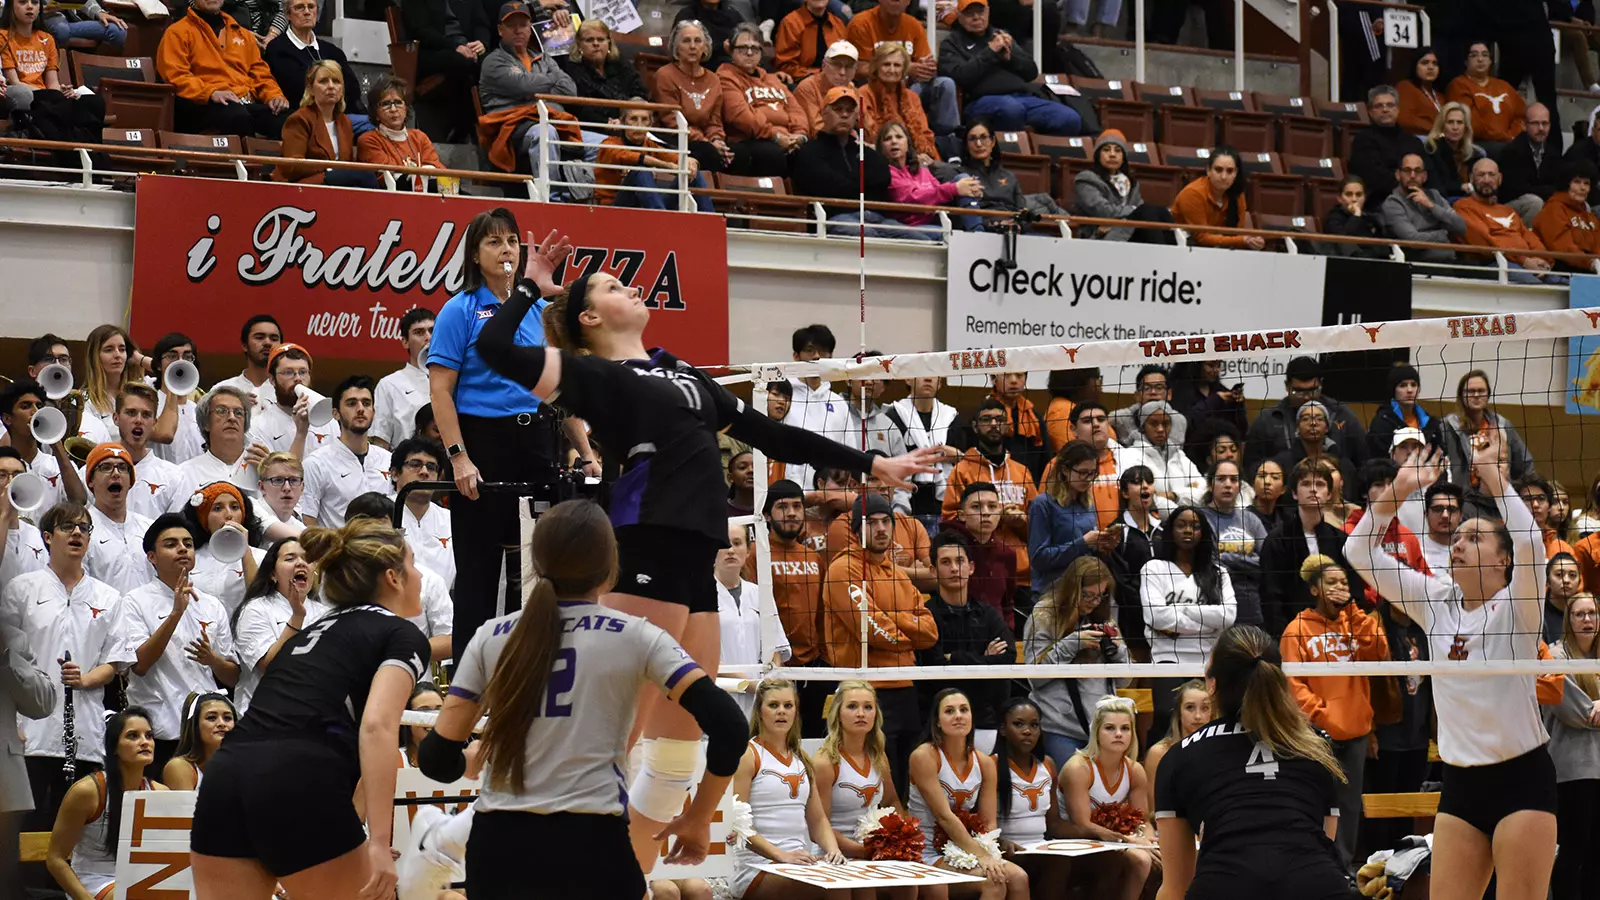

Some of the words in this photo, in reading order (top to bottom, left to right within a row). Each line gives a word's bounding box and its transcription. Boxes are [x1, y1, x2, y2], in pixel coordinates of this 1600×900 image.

[1392, 23, 1410, 43] 34
[16, 49, 47, 62] TEXAS
[129, 60, 139, 68] 15
[129, 132, 138, 140] 14
[216, 138, 226, 146] 15
[187, 214, 222, 283] i
[237, 205, 467, 294] Fratell
[969, 258, 1064, 297] Check
[1070, 272, 1134, 307] your
[1140, 269, 1202, 305] ride:
[307, 311, 362, 337] never
[369, 301, 404, 340] tru
[966, 315, 1047, 337] Remember
[1050, 321, 1065, 338] to
[1068, 320, 1110, 341] check
[1113, 324, 1136, 340] the
[1447, 314, 1518, 338] TEXAS
[1138, 337, 1206, 358] TACO
[1213, 329, 1302, 353] SHACK
[949, 350, 1007, 371] TEXAS
[1272, 358, 1285, 375] in
[771, 561, 819, 576] TEXAS
[290, 618, 339, 656] 3
[493, 615, 628, 637] WCATS
[535, 647, 577, 718] 2
[1245, 741, 1280, 780] 4
